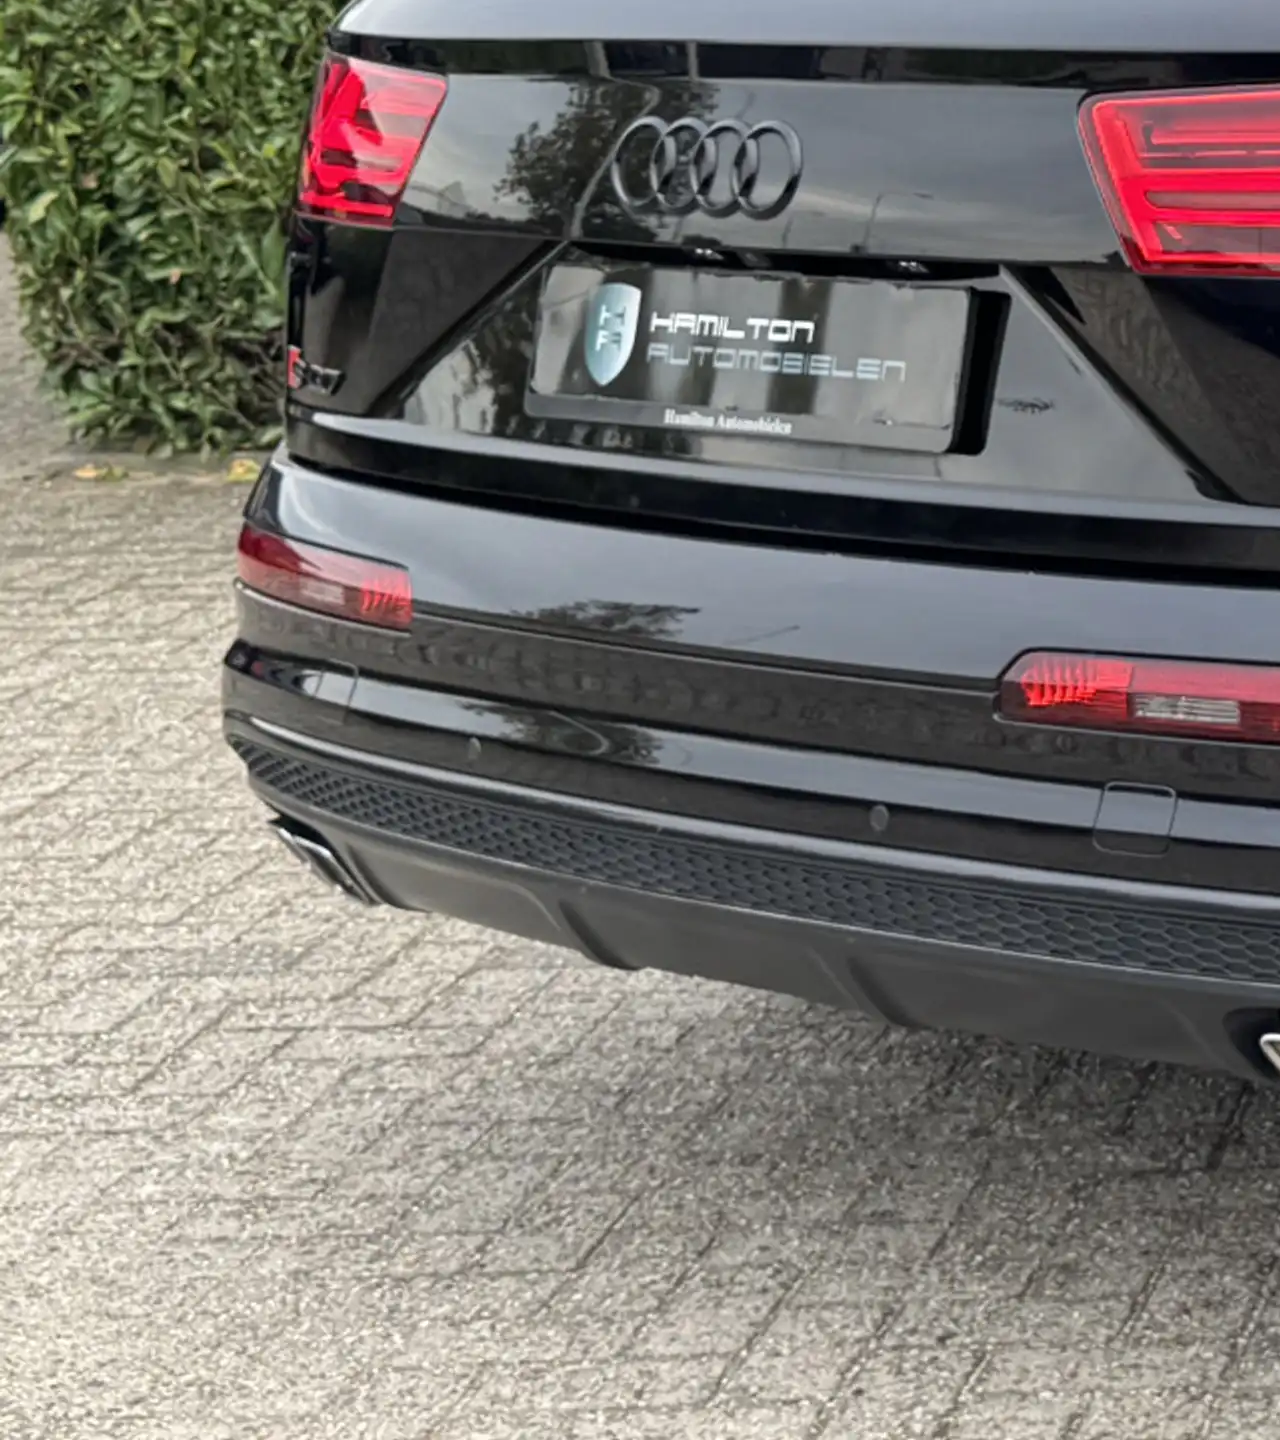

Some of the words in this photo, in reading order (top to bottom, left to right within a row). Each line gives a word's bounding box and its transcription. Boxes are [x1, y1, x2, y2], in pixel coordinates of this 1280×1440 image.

[649, 312, 816, 343] HAMILTON
[647, 342, 906, 383] AUTOMOBIELEN
[664, 408, 715, 428] Hamilton
